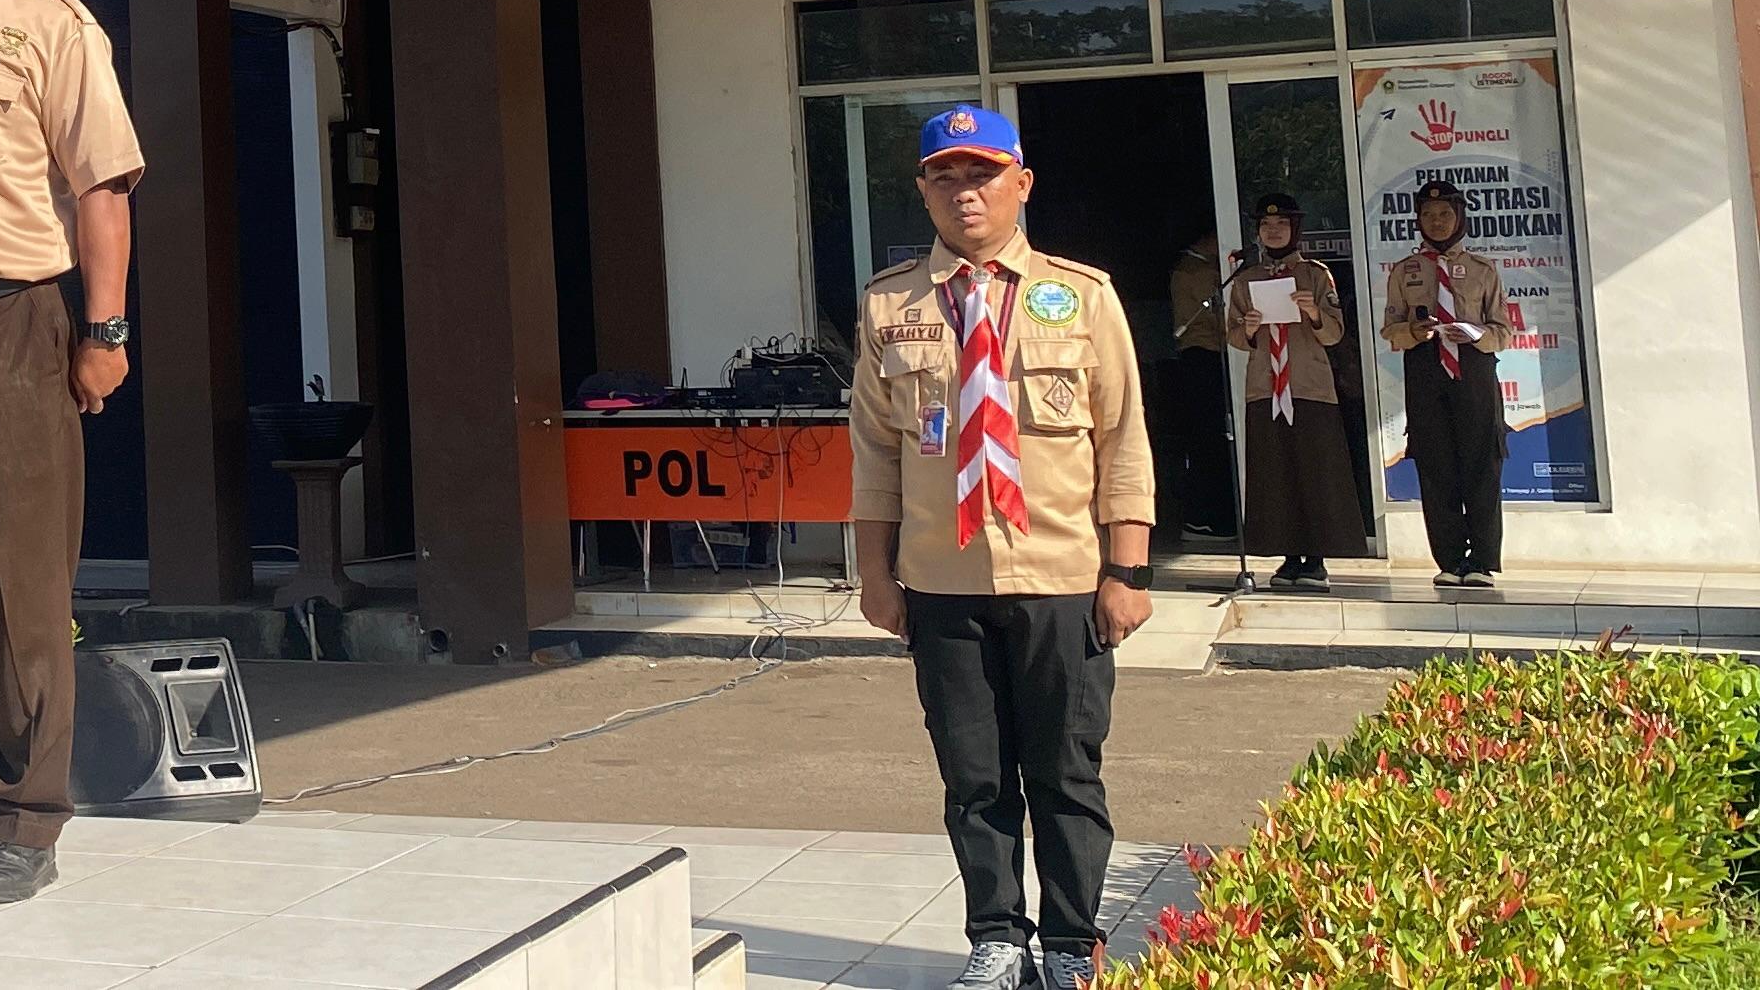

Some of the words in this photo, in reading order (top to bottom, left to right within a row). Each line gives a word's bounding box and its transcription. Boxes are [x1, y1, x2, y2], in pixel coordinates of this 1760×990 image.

[1428, 132, 1454, 146] STOP
[1455, 129, 1510, 143] PUNGLI
[1382, 186, 1551, 215] ADSTRASI
[1379, 213, 1563, 242] KEPUDUKAN
[884, 326, 938, 341] WAHYU
[623, 449, 726, 497] POL
